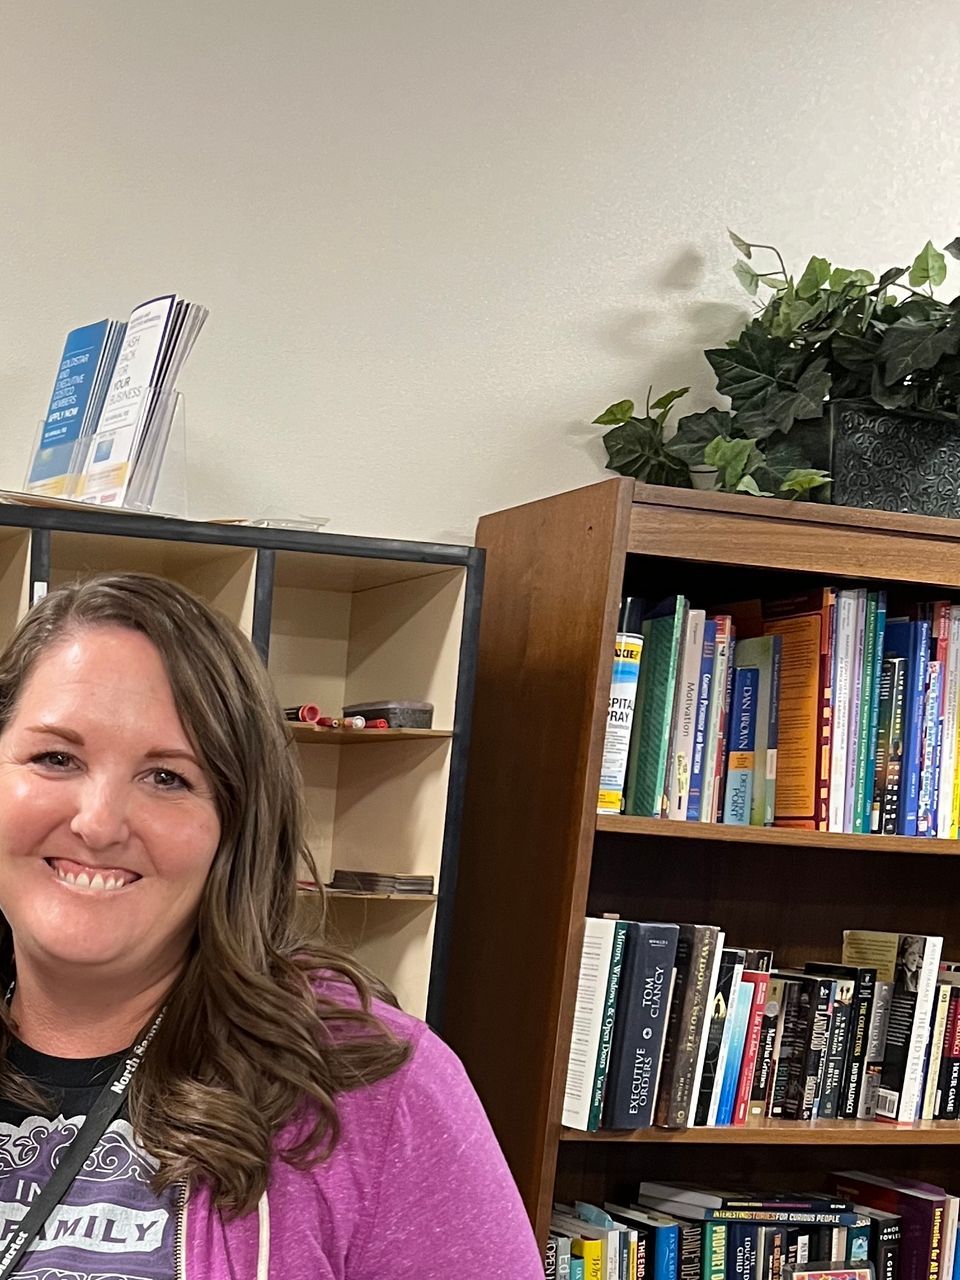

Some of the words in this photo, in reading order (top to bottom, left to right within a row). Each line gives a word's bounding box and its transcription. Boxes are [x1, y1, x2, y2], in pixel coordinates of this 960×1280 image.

[920, 623, 928, 656] Speaking
[682, 681, 696, 737] Motivation
[742, 687, 753, 709] DAN
[929, 696, 937, 722] FIRST
[739, 713, 751, 749] BROWN
[927, 726, 935, 748] DAYS
[922, 764, 931, 799] SCHOOL
[730, 788, 740, 817] POINT
[737, 773, 748, 821] DECEPTION
[613, 929, 627, 963] Mirrors,
[697, 945, 710, 989] WIDOW
[607, 965, 622, 1006] Windows,
[642, 978, 654, 1008] TOM
[650, 967, 664, 1018] CLANCY
[608, 1007, 615, 1015] &
[860, 1001, 868, 1015] THE
[917, 1011, 927, 1031] THE
[601, 1018, 614, 1042] Open
[686, 1005, 702, 1051] SOUTH
[763, 1027, 776, 1058] Martha
[810, 1011, 829, 1050] LANDLORD
[832, 1027, 840, 1055] WOODS
[854, 1016, 866, 1056] COLLECTORS
[599, 1043, 611, 1068] Doors
[914, 1033, 925, 1053] RED
[110, 1057, 140, 1094] North
[597, 1075, 605, 1088] Van
[629, 1048, 645, 1114] EXECUTIVE
[639, 1057, 652, 1106] ORDERS
[759, 1058, 771, 1088] Grimes
[825, 1062, 835, 1094] BRYSON
[832, 1069, 840, 1088] BILL
[850, 1062, 860, 1081] DAVID
[909, 1056, 921, 1082] TENT
[949, 1062, 959, 1087] HOUR
[845, 1082, 857, 1113] BALDACCI
[946, 1088, 957, 1112] GAME
[1, 1217, 158, 1243] FMILY
[713, 1210, 750, 1219] INTERESTING
[750, 1211, 776, 1220] STORIES
[775, 1212, 787, 1221] FOR
[788, 1213, 815, 1222] CURIOUS
[815, 1214, 840, 1223] PEOPLE
[931, 1208, 944, 1247] Instruction
[682, 1228, 701, 1257] DANCE
[711, 1226, 725, 1270] PROPHET
[930, 1249, 940, 1261] for
[637, 1258, 645, 1278] END
[736, 1247, 744, 1273] CHILD
[743, 1237, 751, 1280] EDUCATED
[929, 1261, 939, 1273] All
